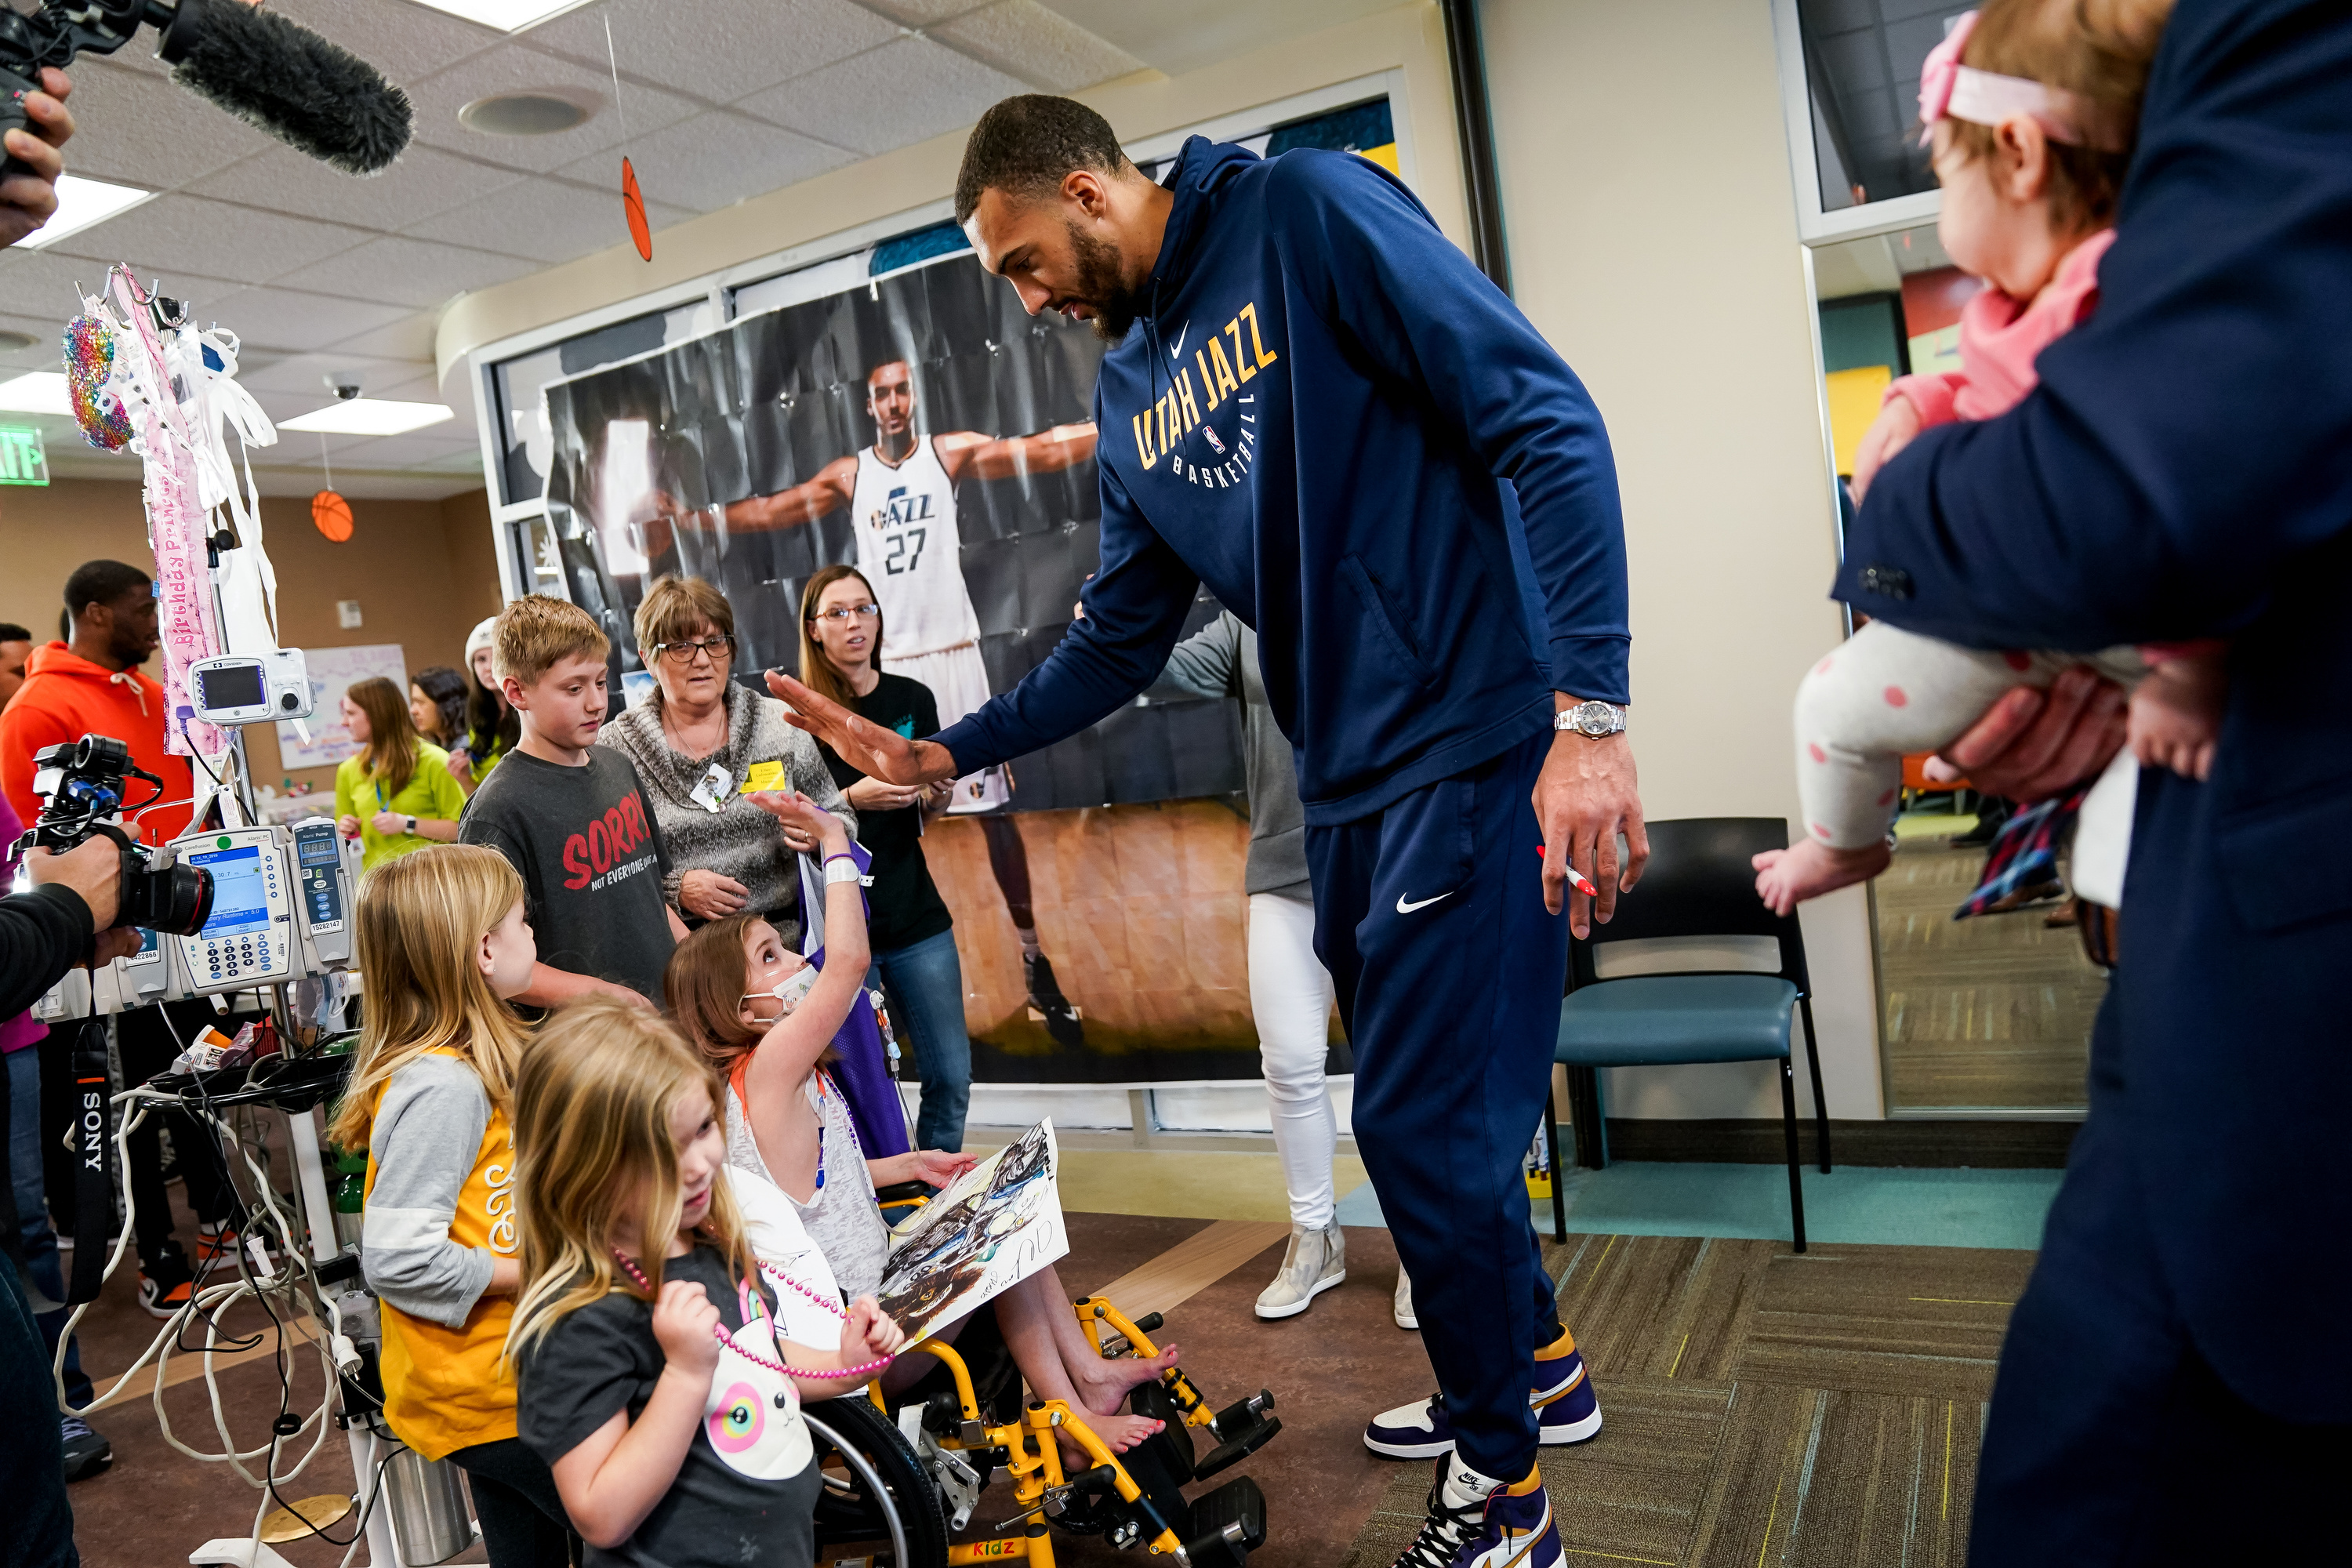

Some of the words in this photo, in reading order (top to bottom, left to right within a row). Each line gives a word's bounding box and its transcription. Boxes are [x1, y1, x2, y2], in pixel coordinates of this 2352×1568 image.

[1132, 366, 1201, 470] UTAH
[1196, 301, 1278, 412] JAZZ
[0, 432, 34, 479] IT
[1173, 394, 1255, 488] BASKETBALL
[885, 528, 927, 575] 27
[169, 556, 194, 645] Birthday
[591, 877, 605, 891] NOT
[606, 858, 644, 886] EVERYONE
[312, 920, 339, 931] 15282147
[84, 1092, 102, 1172] SONY
[1462, 1472, 1480, 1483] NIKE
